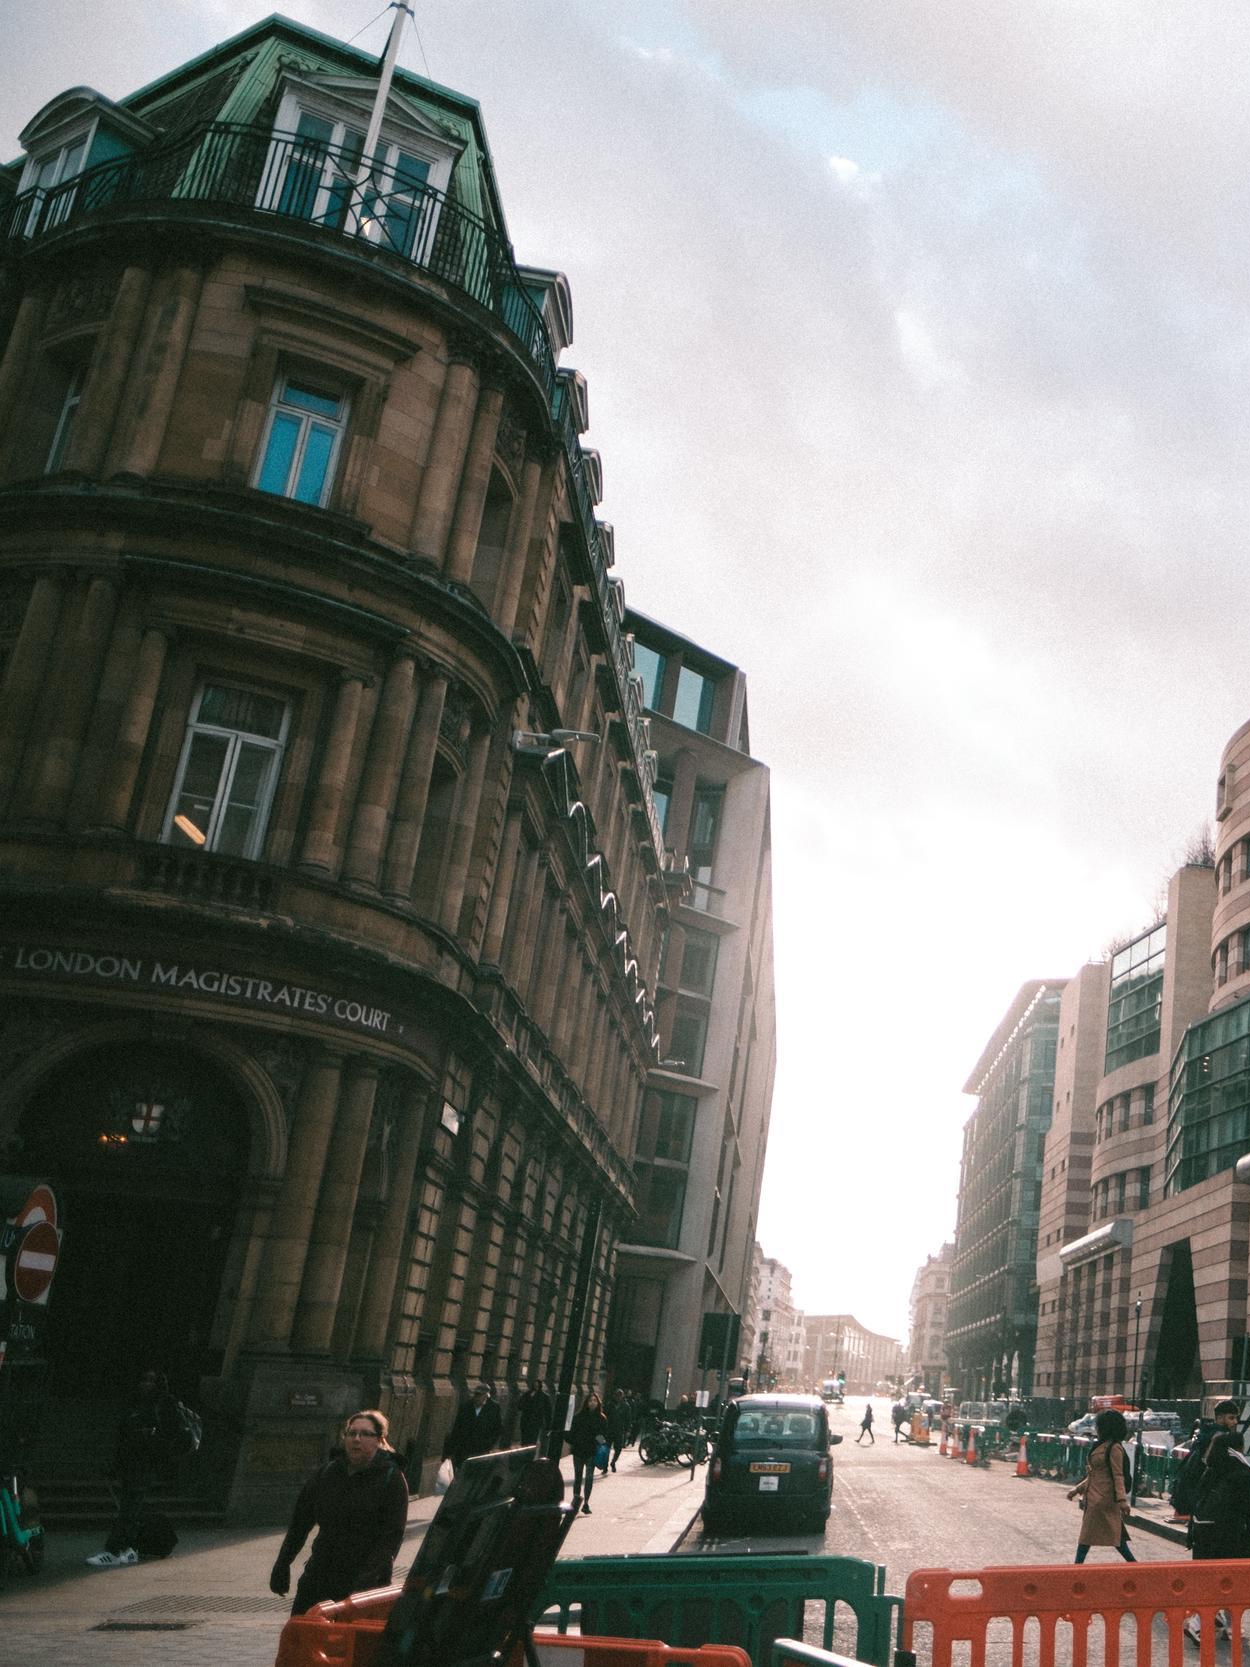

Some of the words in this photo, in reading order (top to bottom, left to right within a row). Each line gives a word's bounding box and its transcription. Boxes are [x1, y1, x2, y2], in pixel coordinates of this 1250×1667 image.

[15, 949, 143, 981] LONDON
[151, 963, 332, 1013] MAGISTRATES'
[334, 999, 391, 1031] COURT
